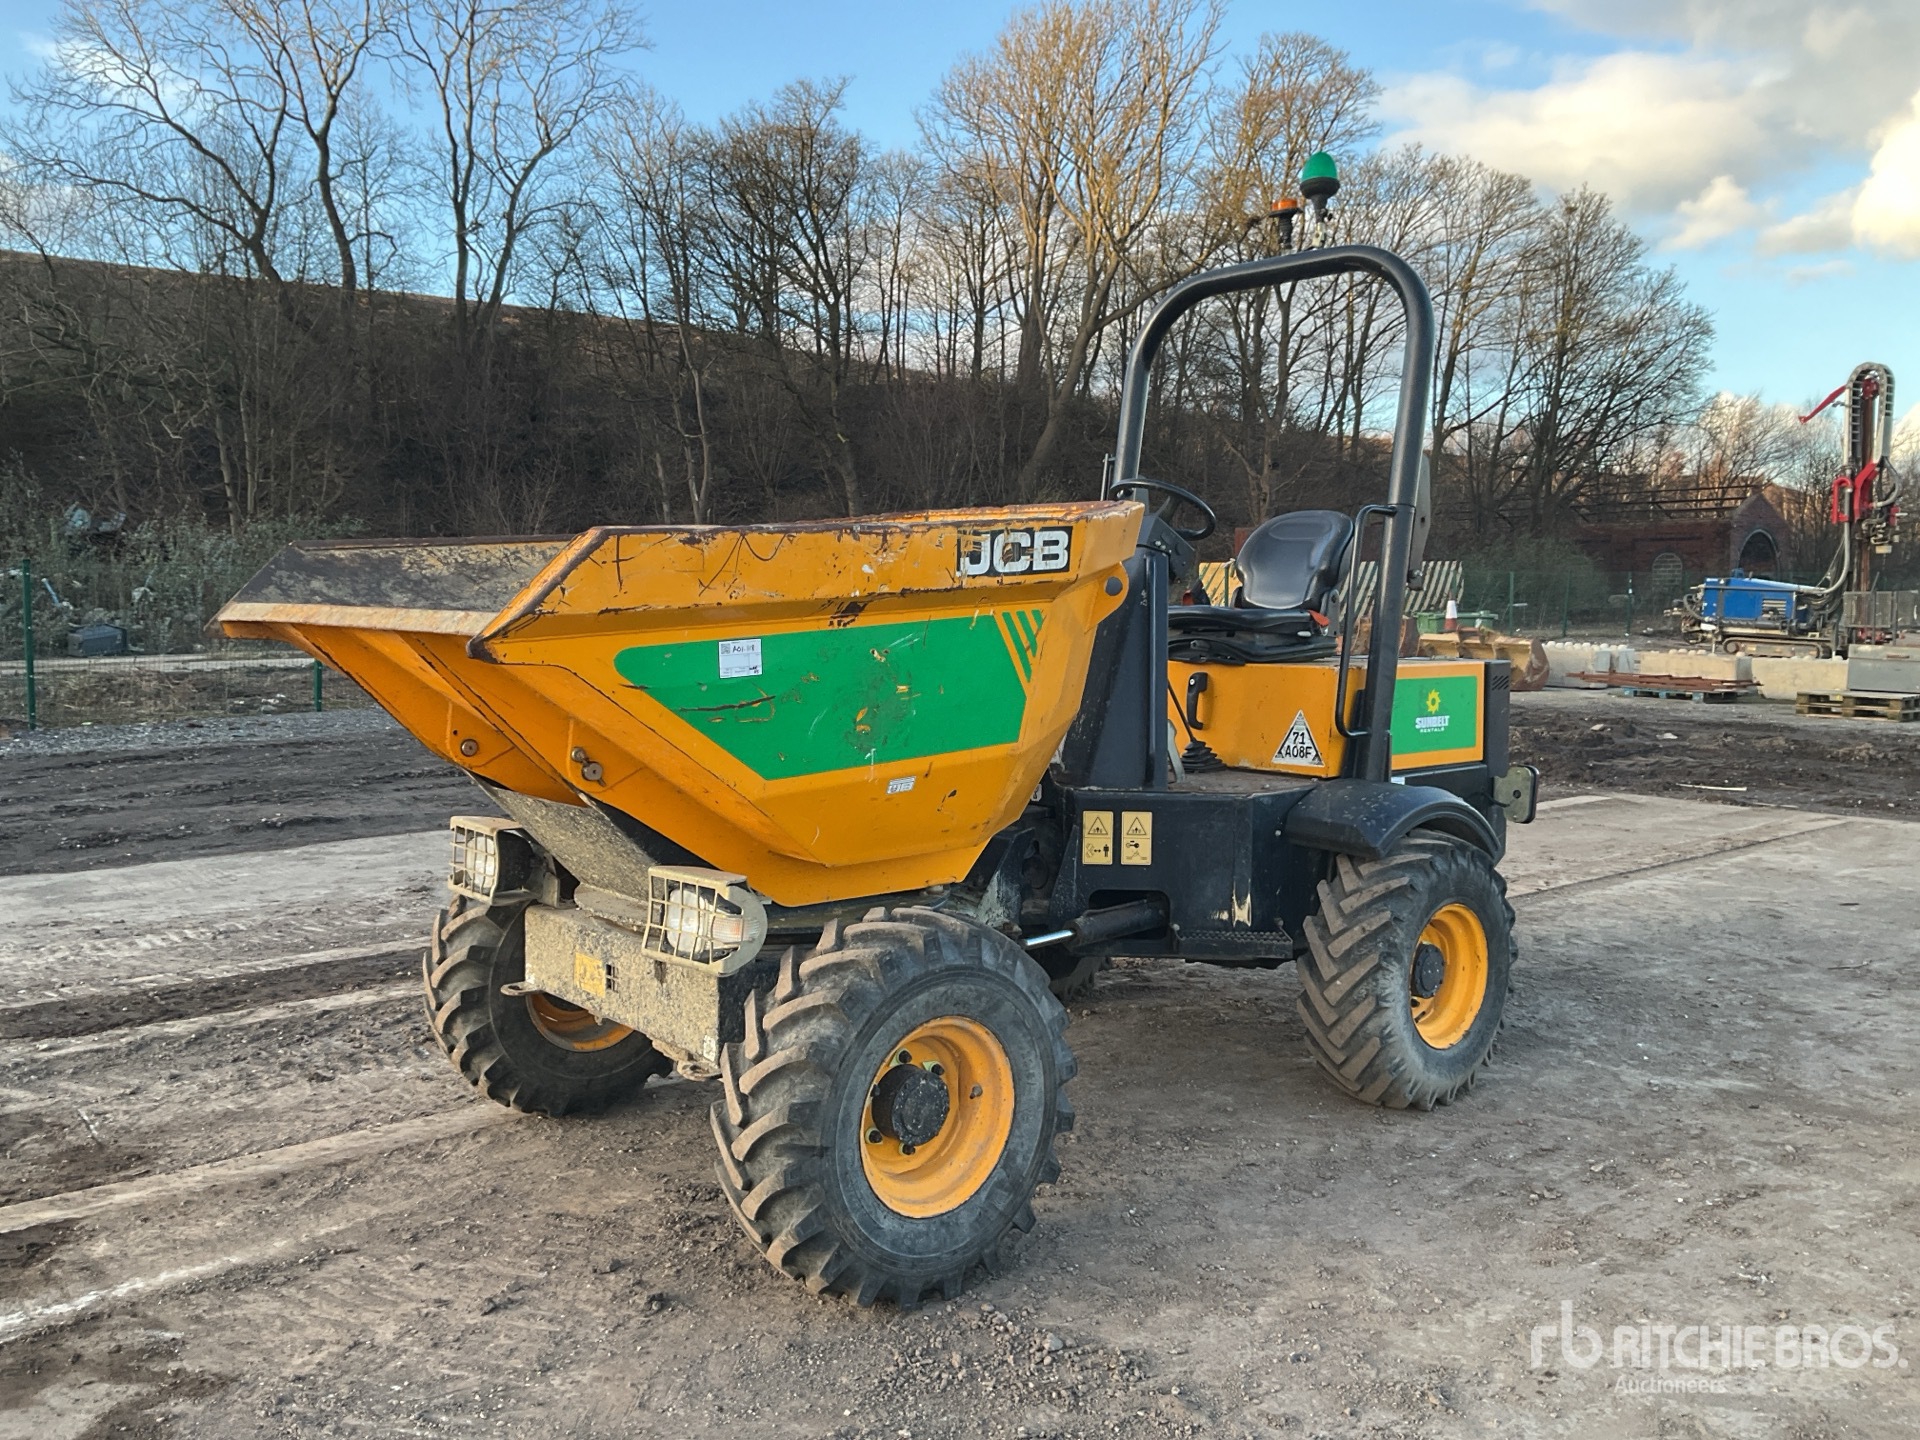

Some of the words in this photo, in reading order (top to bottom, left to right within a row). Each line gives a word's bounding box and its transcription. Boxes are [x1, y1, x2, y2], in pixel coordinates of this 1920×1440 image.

[960, 530, 1069, 575] JCB
[1292, 731, 1306, 745] 71
[1284, 744, 1313, 759] A08F
